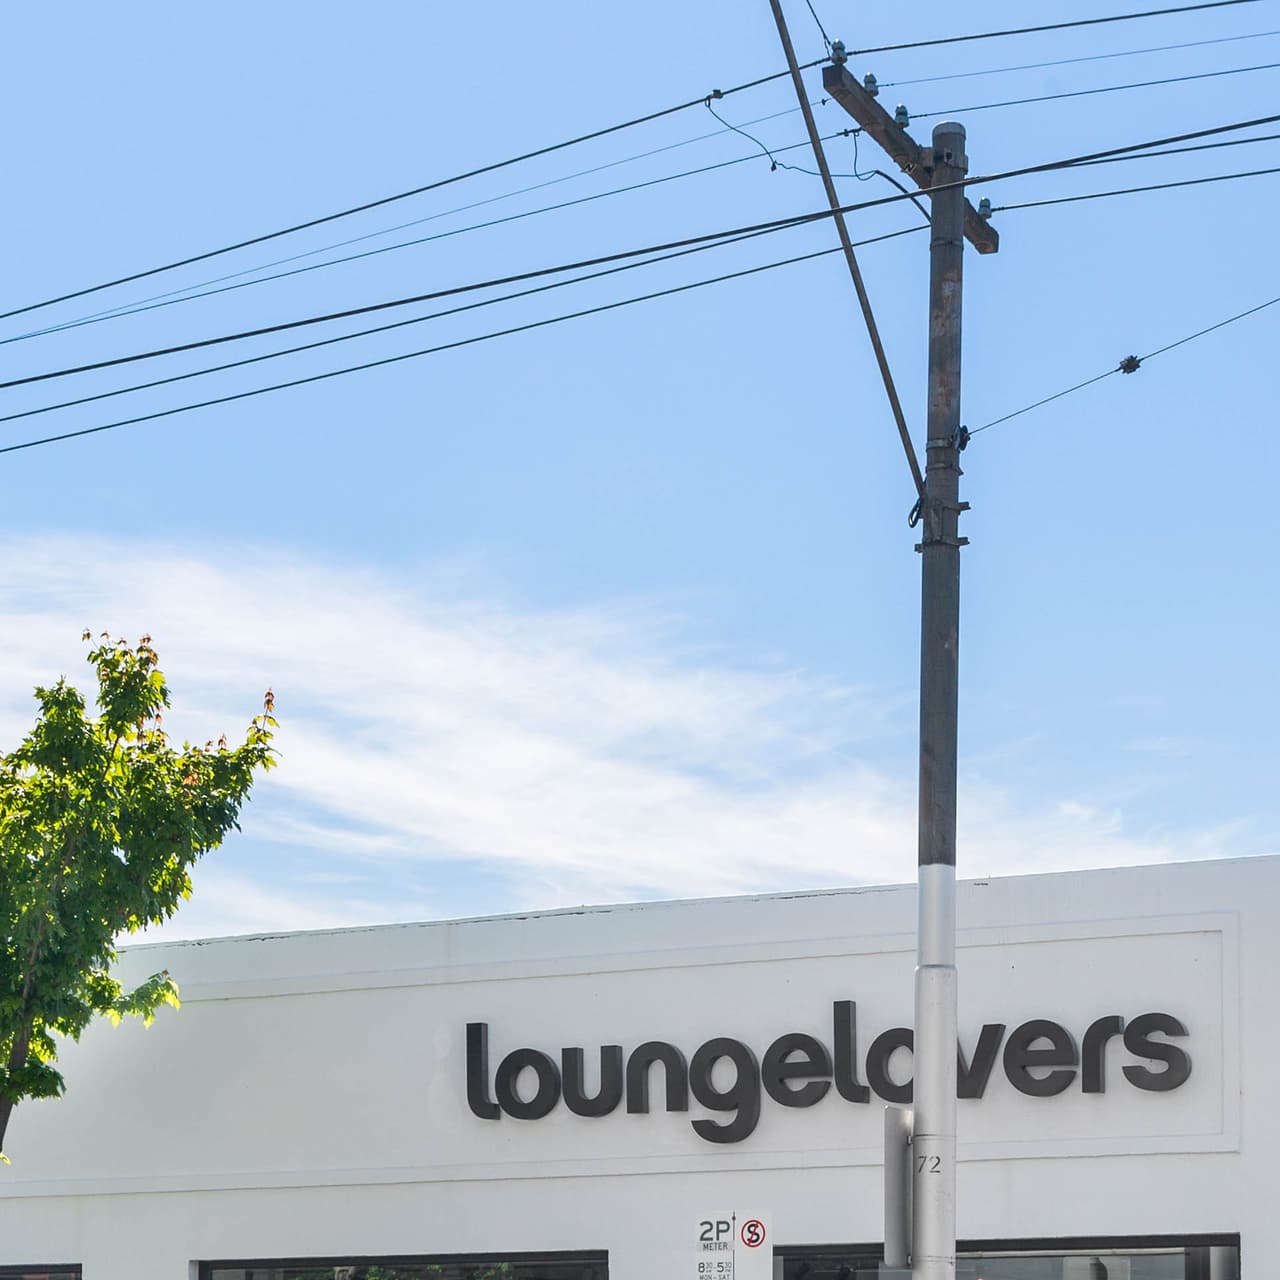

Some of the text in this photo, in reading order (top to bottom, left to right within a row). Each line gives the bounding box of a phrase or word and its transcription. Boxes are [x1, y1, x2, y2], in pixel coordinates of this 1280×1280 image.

[466, 1000, 1193, 1143] loungelovers
[918, 1155, 941, 1173] 72
[700, 1221, 730, 1241] 2P
[703, 1242, 728, 1251] METER
